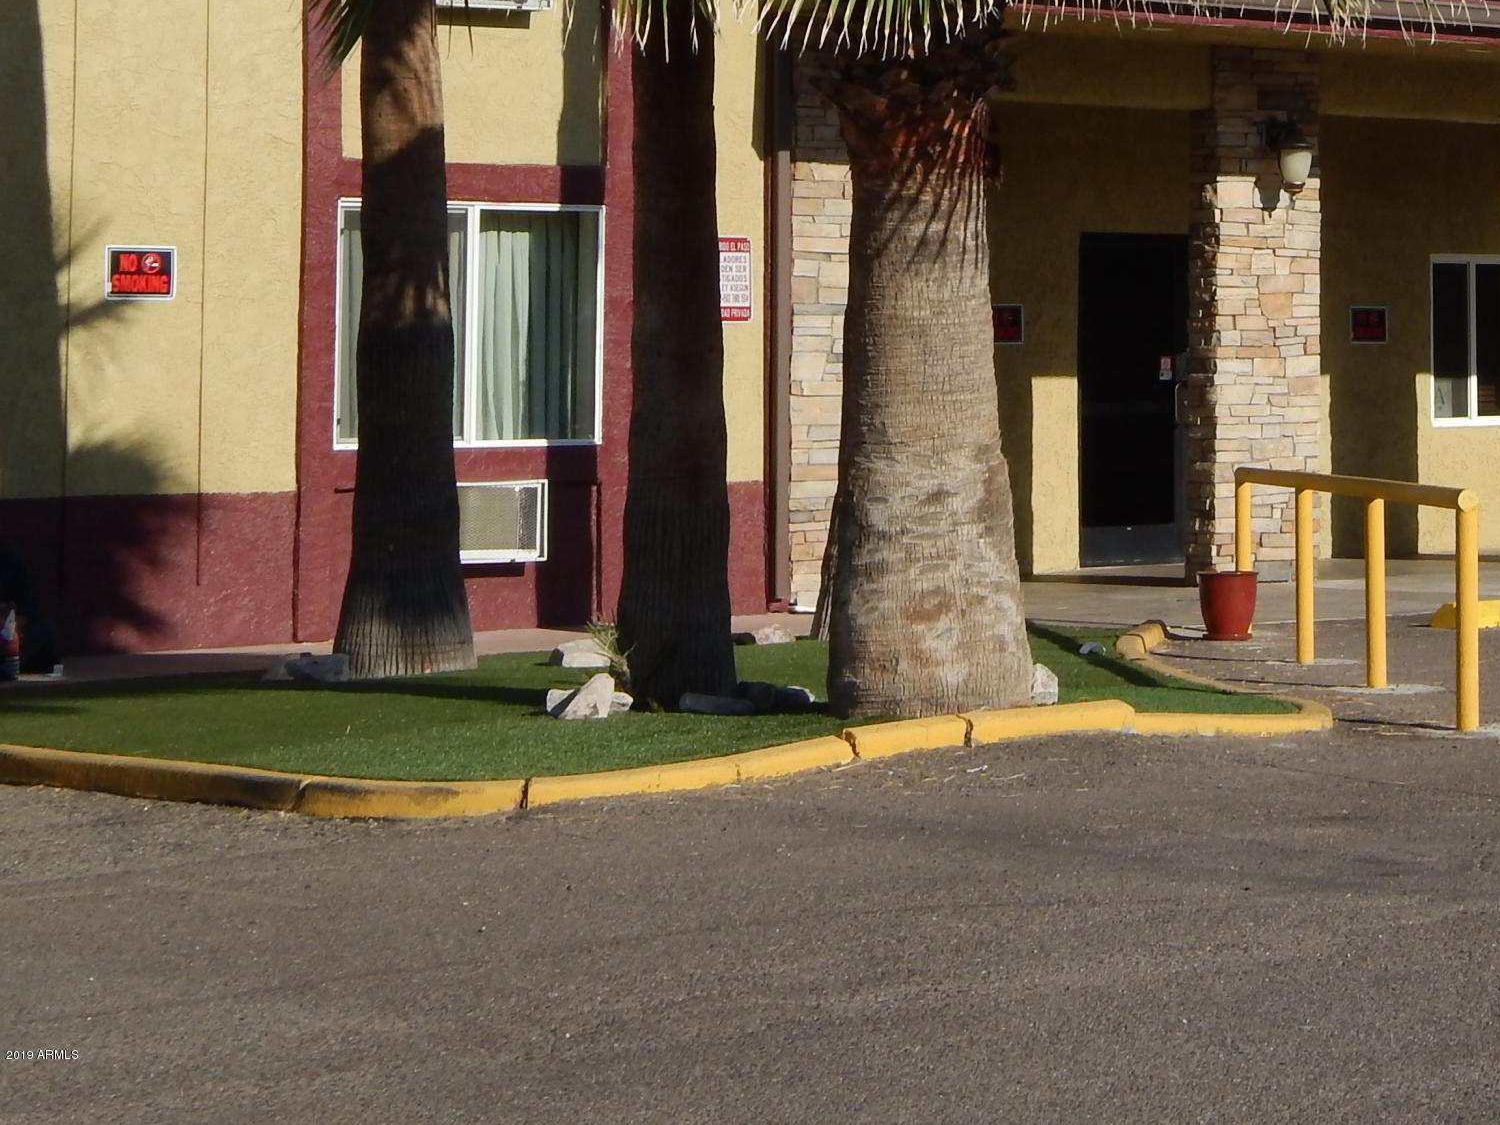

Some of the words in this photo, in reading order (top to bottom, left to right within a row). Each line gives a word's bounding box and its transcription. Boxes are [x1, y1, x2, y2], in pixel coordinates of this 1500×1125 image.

[119, 253, 138, 272] NO
[721, 255, 747, 263] ADORES
[112, 274, 168, 292] SMOKING
